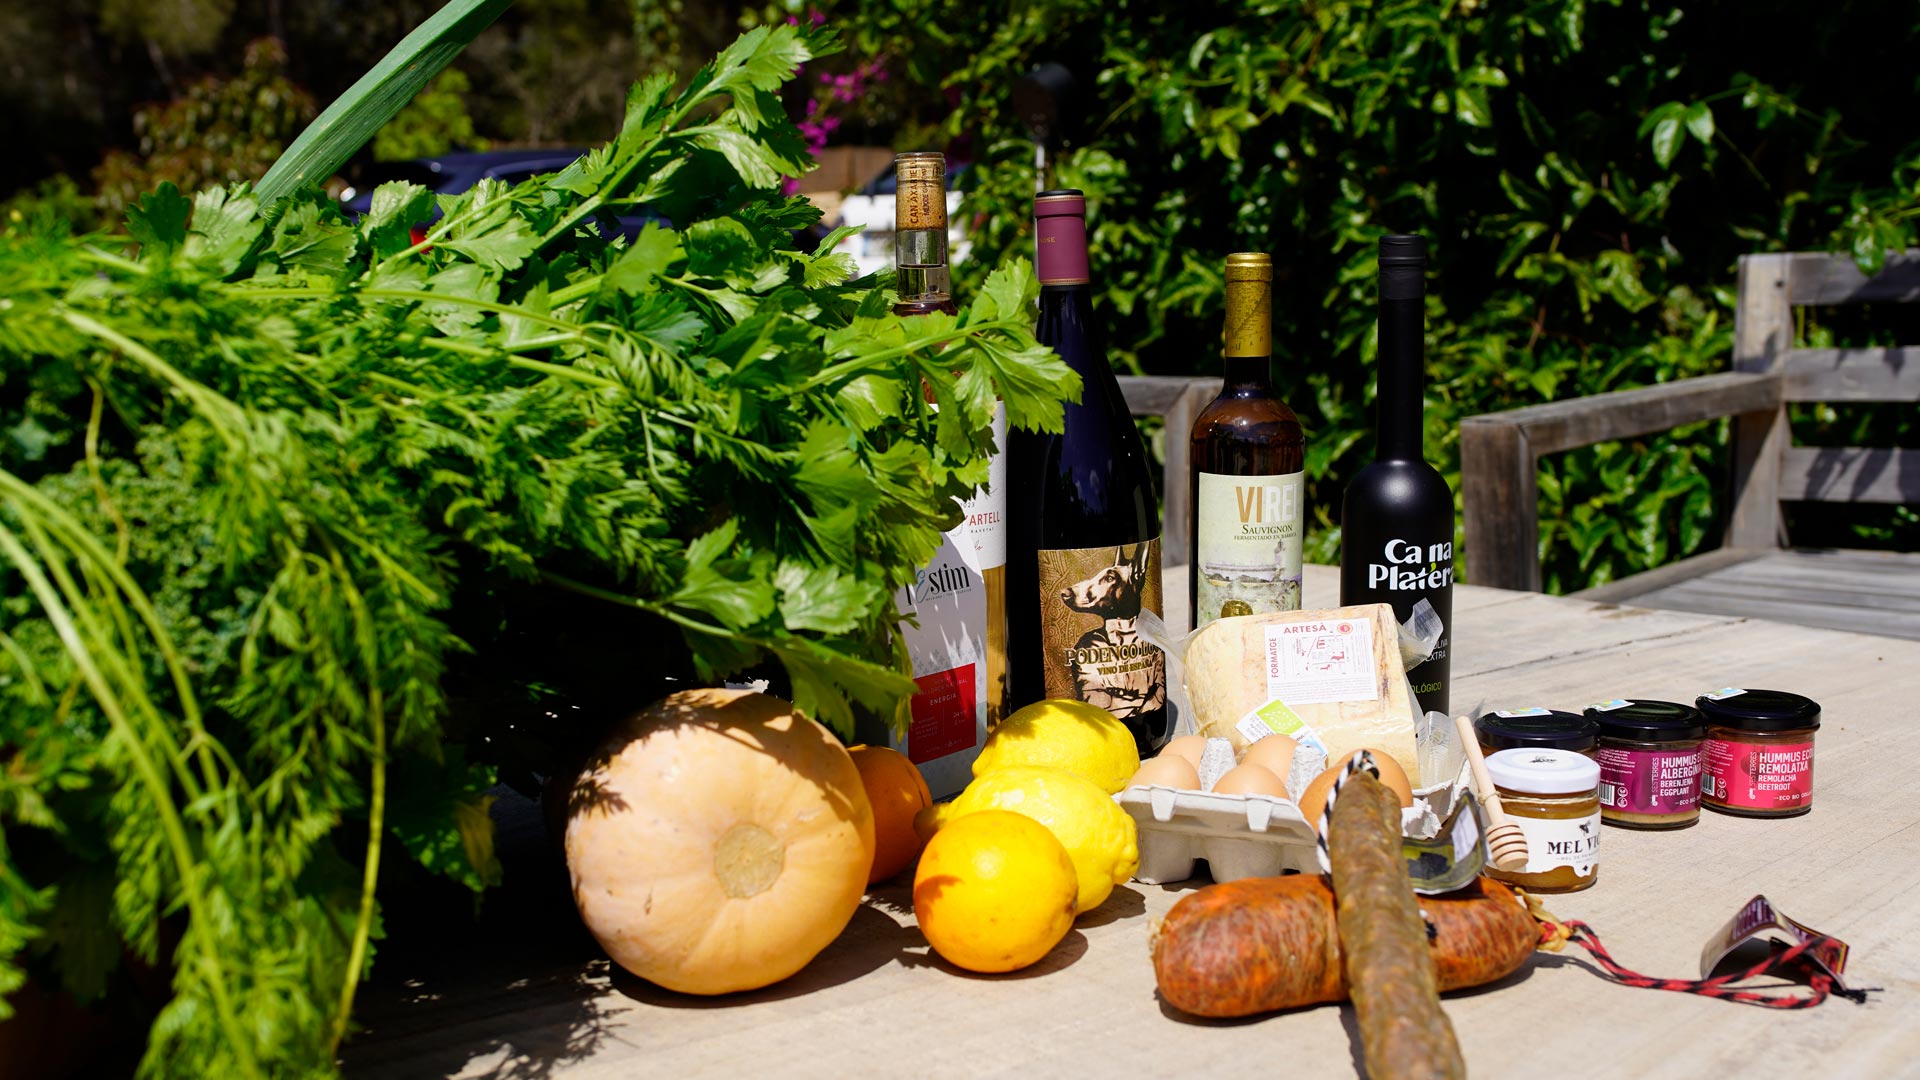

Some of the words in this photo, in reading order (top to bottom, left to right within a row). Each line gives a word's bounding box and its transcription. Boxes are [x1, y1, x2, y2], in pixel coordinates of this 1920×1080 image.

[910, 205, 919, 224] CAN
[964, 511, 1000, 526] ARTELL
[1384, 539, 1422, 564] Ca
[1428, 541, 1451, 562] na
[1064, 643, 1138, 667] PODENCO
[1269, 637, 1279, 678] FORMATGE
[1096, 665, 1118, 676] VINO
[1118, 663, 1129, 673] DE
[1411, 681, 1442, 694] OLÓGICO
[929, 692, 957, 706] ENERGIA
[1661, 754, 1697, 768] HUMMUS
[1760, 751, 1801, 763] HUMMUS
[1759, 761, 1809, 774] REMOLATXA
[1660, 777, 1693, 788] BERENJENA
[1758, 774, 1797, 782] REMOLACHA
[1660, 786, 1690, 797] EGGPLANT
[1757, 783, 1791, 791] BEETROOT
[1547, 840, 1583, 855] MEL
